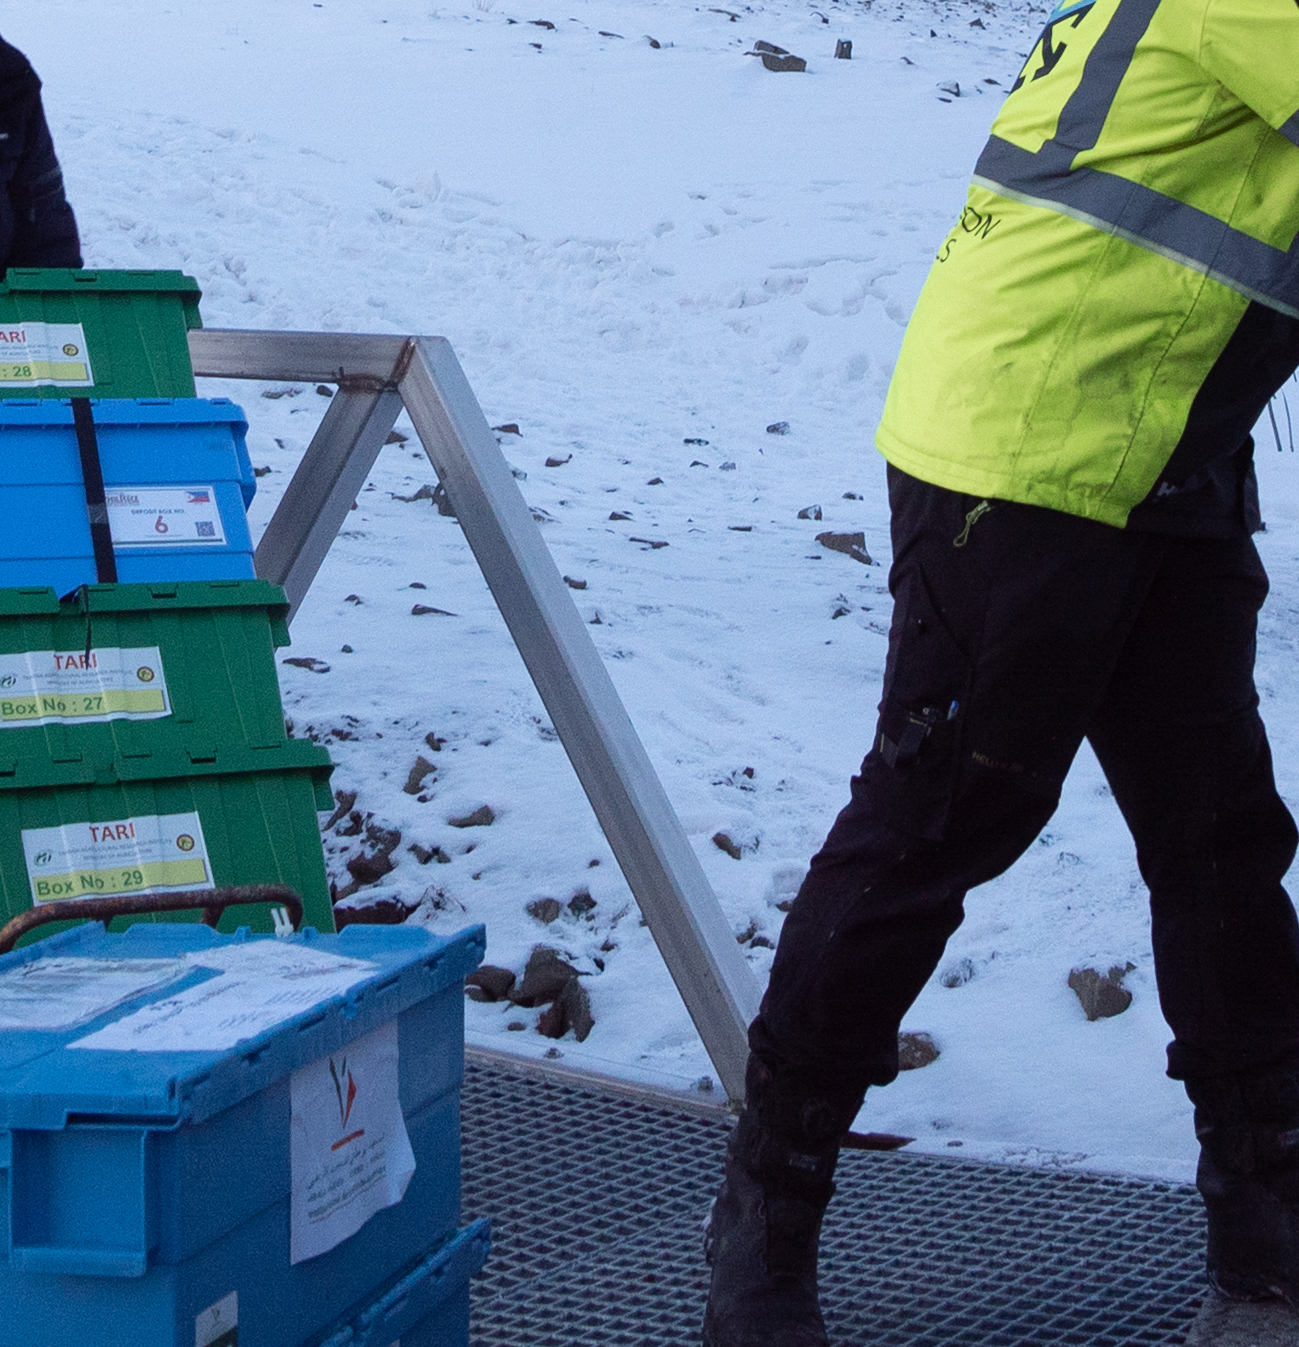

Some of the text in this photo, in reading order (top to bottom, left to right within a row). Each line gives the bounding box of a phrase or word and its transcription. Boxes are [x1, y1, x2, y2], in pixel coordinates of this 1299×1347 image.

[12, 365, 32, 377] 28
[155, 515, 168, 534] 6
[54, 654, 98, 670] TARI
[2, 701, 38, 716] Box
[43, 698, 66, 712] No
[83, 697, 103, 712] 27
[89, 822, 135, 842] TARI
[36, 880, 74, 896] Box
[80, 874, 104, 890] No
[122, 870, 143, 886] 29
